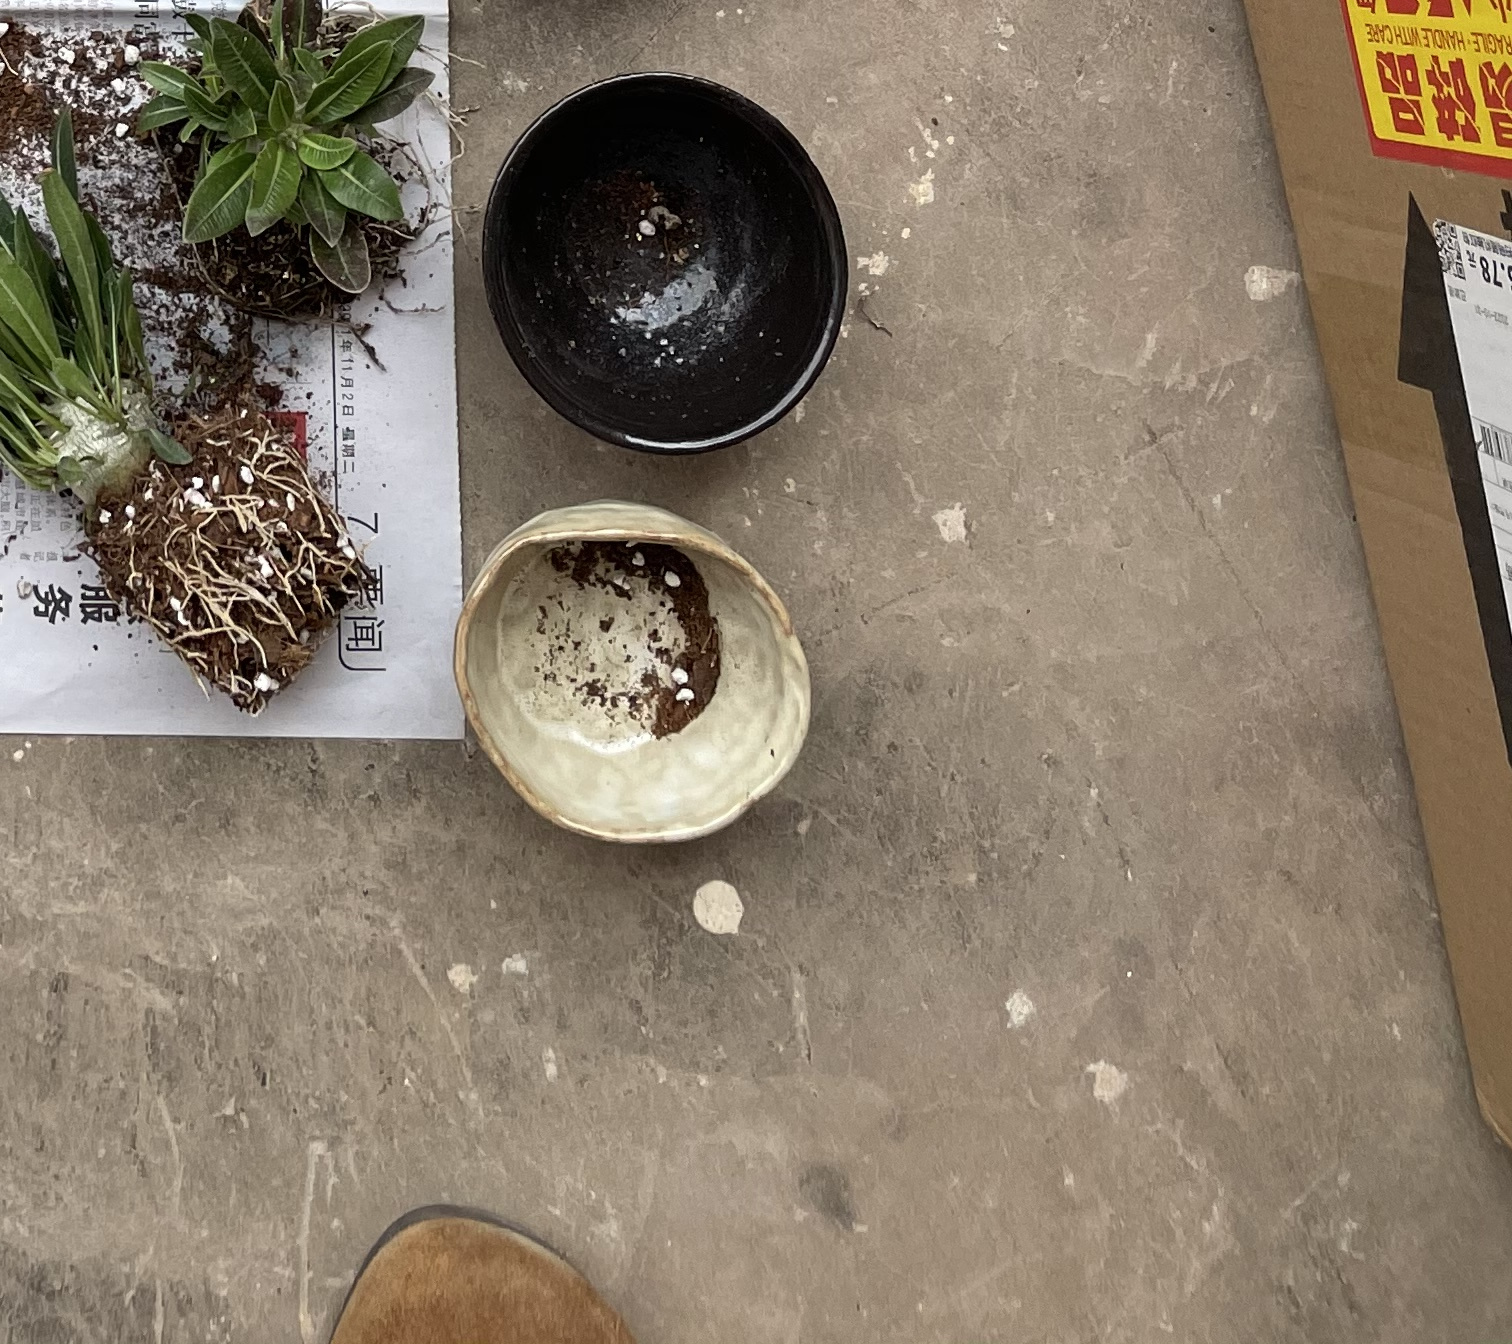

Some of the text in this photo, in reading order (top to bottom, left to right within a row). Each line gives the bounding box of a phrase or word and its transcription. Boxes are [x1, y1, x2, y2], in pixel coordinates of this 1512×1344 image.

[1364, 22, 1394, 45] CARE
[1393, 25, 1421, 47] WITH
[1421, 26, 1466, 50] HANDLE
